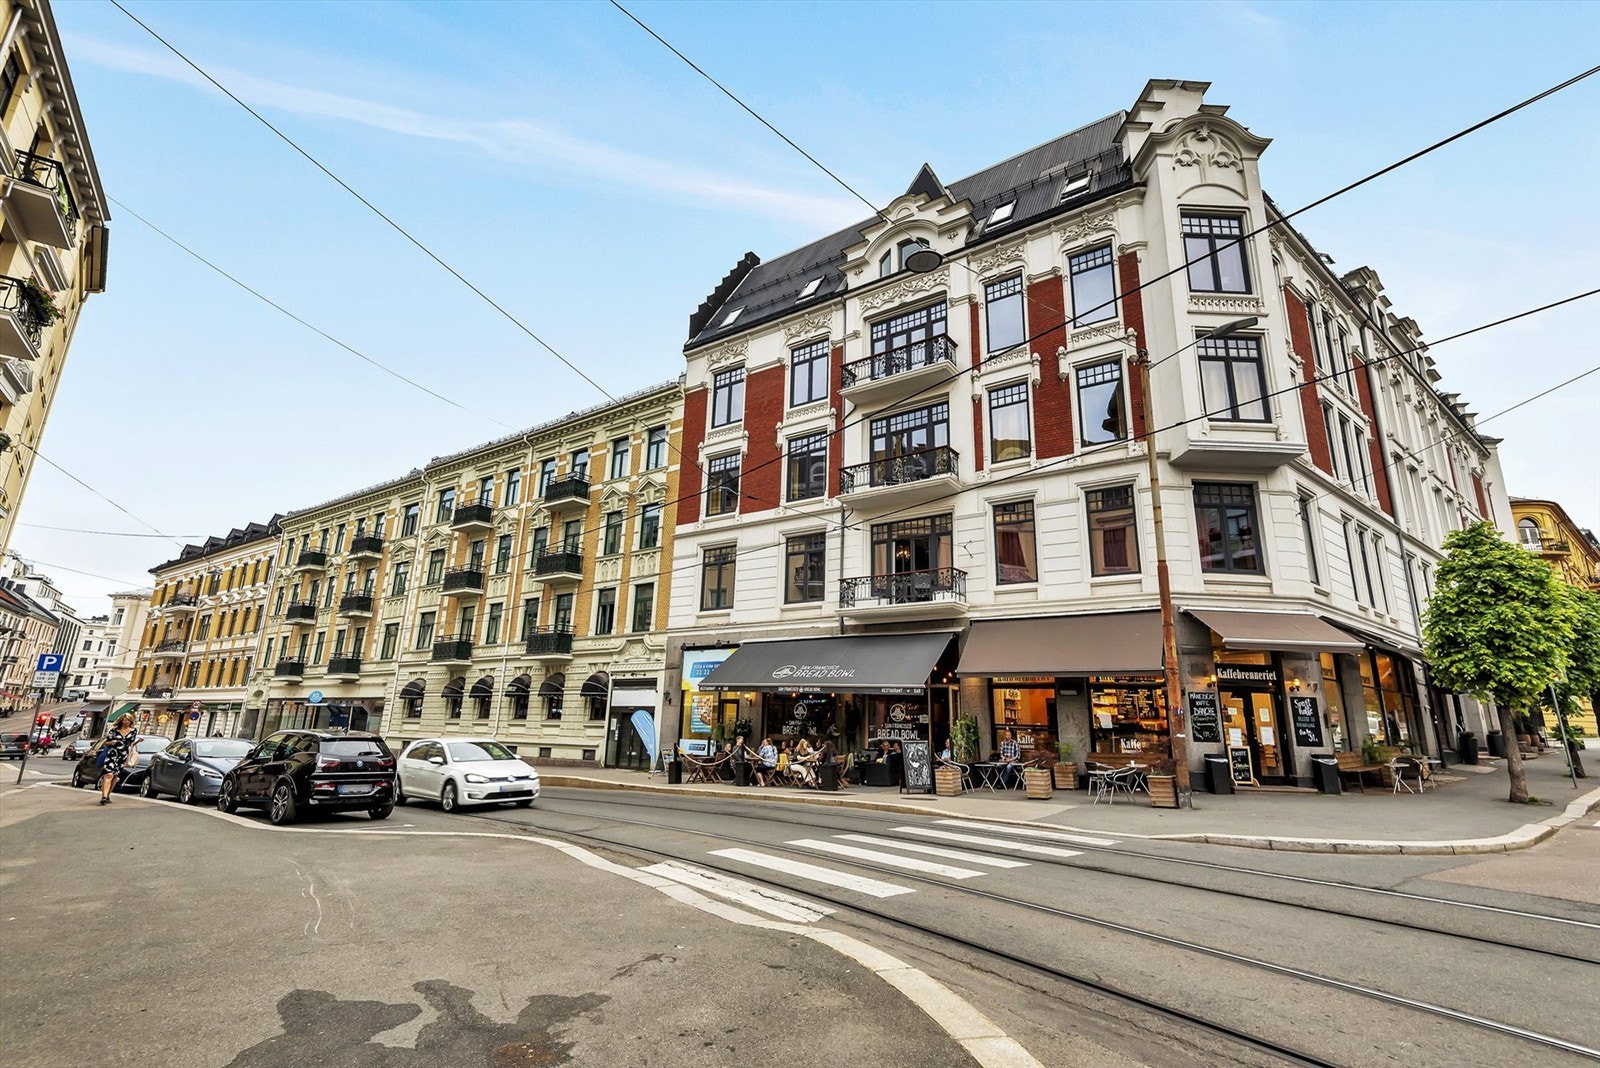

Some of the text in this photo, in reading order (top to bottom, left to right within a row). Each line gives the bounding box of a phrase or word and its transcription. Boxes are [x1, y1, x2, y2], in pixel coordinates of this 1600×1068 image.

[43, 656, 57, 669] P
[793, 669, 856, 678] BREAD BOWL
[1217, 668, 1277, 680] Kaffebrenneriet
[877, 729, 920, 740] BREAD BOWL
[1120, 738, 1142, 749] Kaffe
